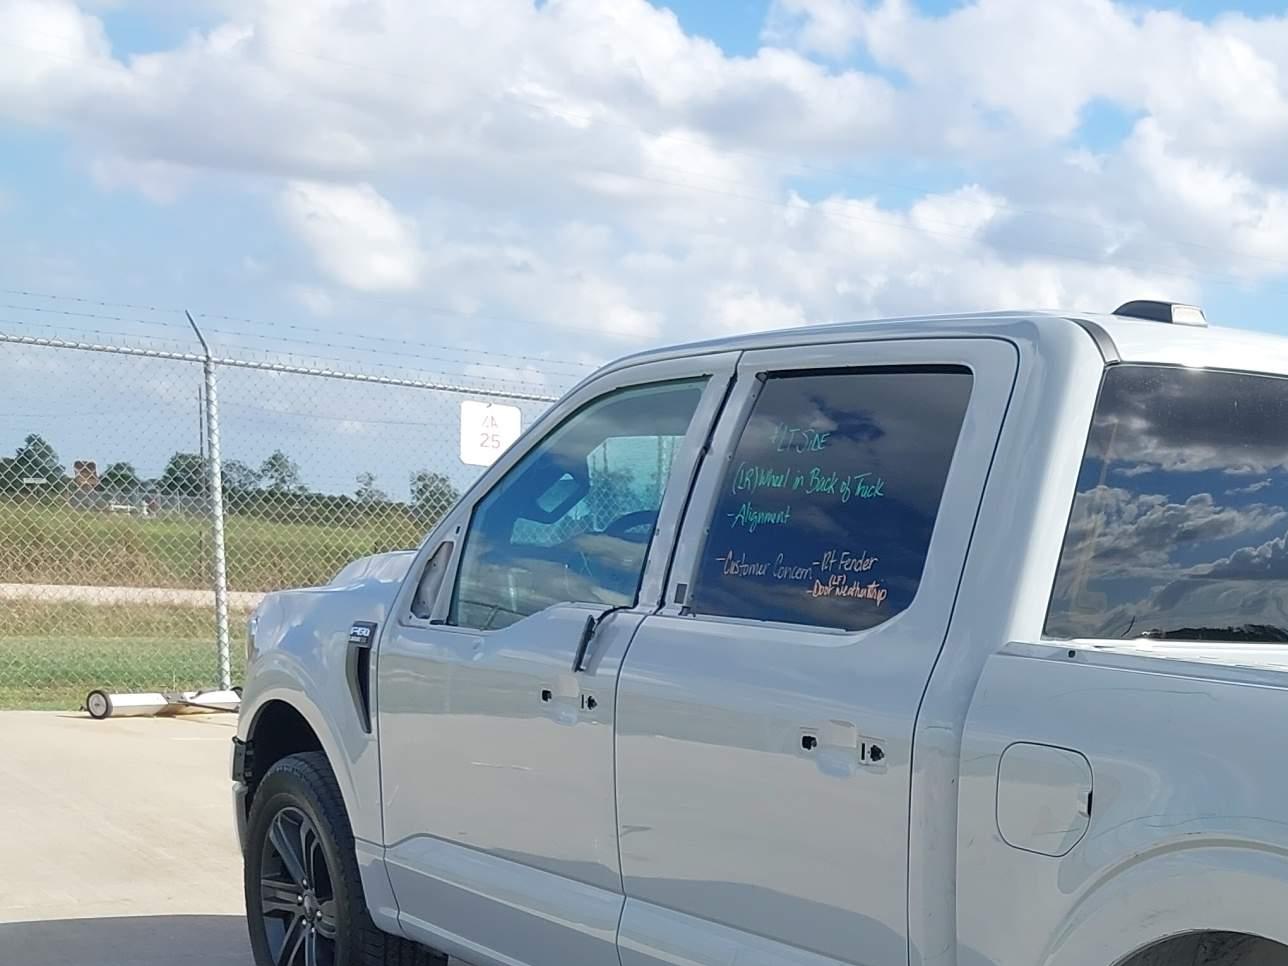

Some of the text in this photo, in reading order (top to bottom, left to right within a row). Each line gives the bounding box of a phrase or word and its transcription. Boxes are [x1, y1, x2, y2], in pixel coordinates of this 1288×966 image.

[479, 432, 501, 449] 25
[806, 466, 838, 495] Back
[840, 475, 851, 503] of
[838, 551, 880, 573] Fender
